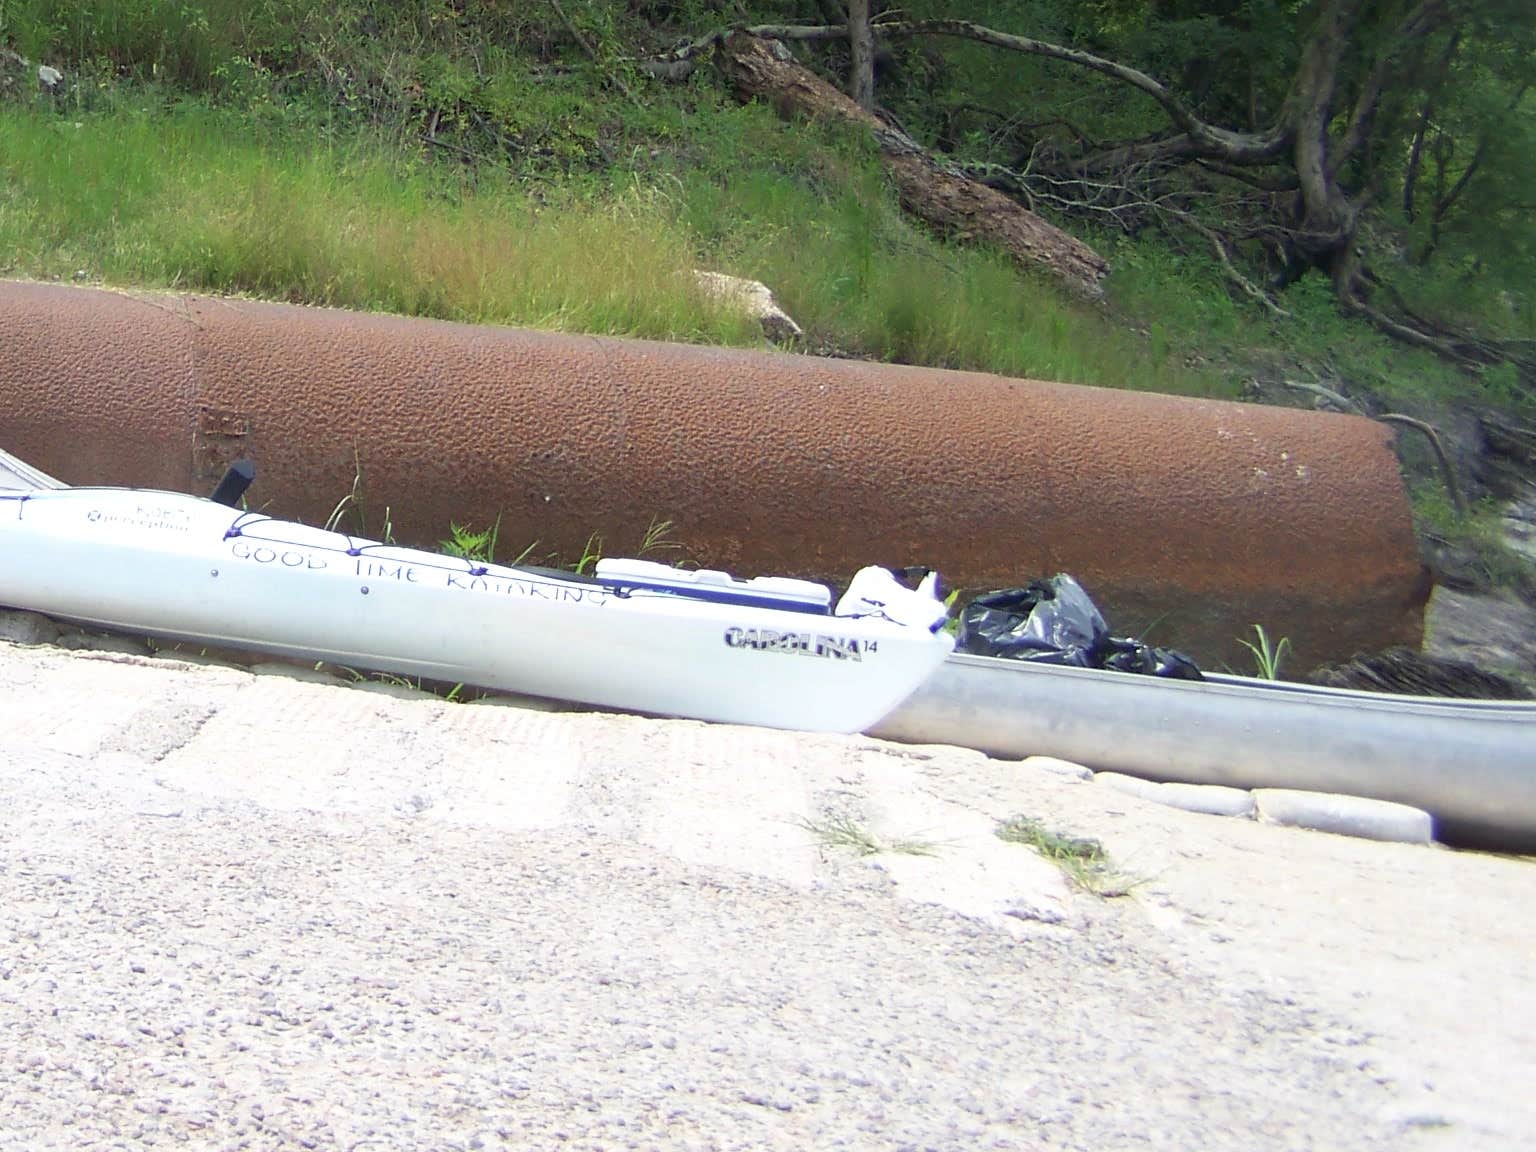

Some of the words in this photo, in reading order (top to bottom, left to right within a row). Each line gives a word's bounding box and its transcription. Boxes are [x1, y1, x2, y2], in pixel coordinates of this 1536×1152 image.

[232, 542, 327, 569] GOOD
[724, 626, 862, 663] CAROLINA
[863, 639, 878, 653] 14
